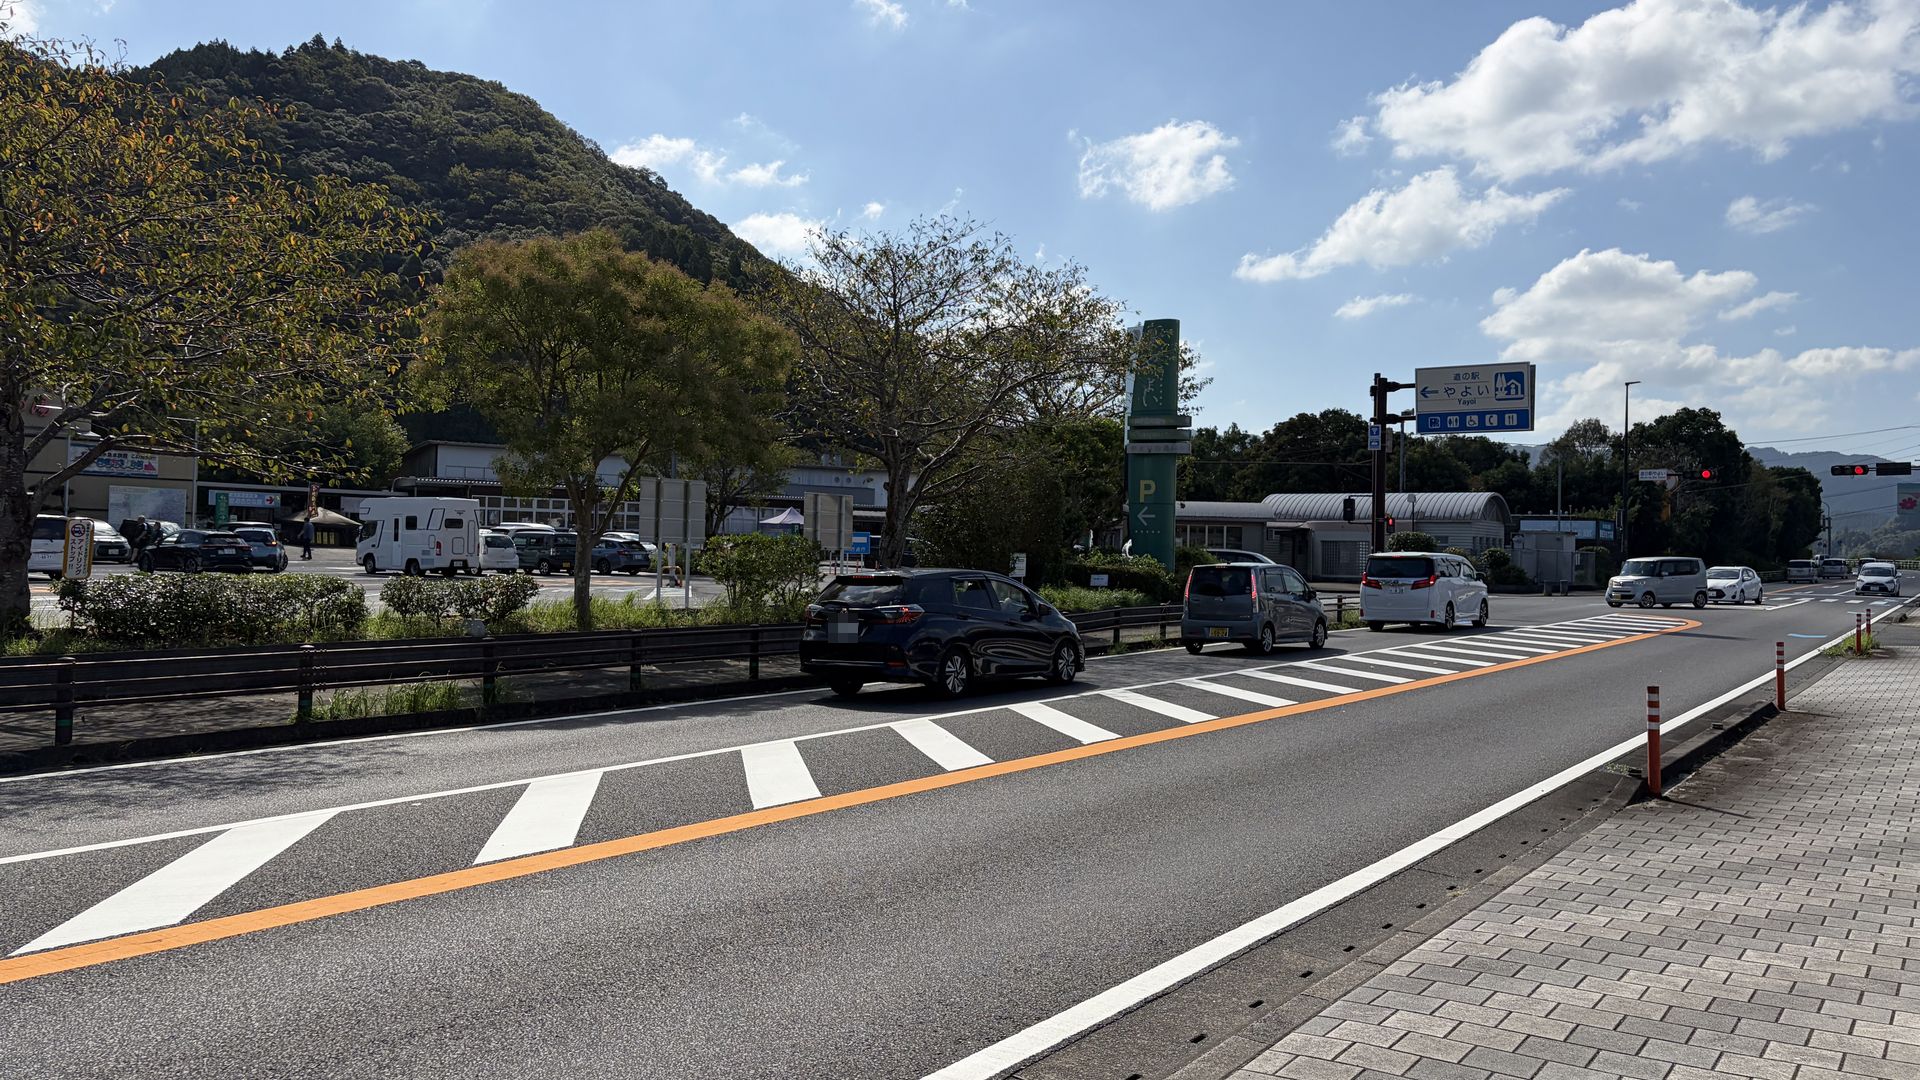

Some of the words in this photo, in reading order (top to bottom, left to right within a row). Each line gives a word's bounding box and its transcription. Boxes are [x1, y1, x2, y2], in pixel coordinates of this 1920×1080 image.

[1453, 371, 1480, 381] 道の駅
[1443, 385, 1490, 398] やよい
[1457, 398, 1477, 406] Yayoi
[1139, 479, 1156, 504] P
[76, 538, 84, 576] アイドリング
